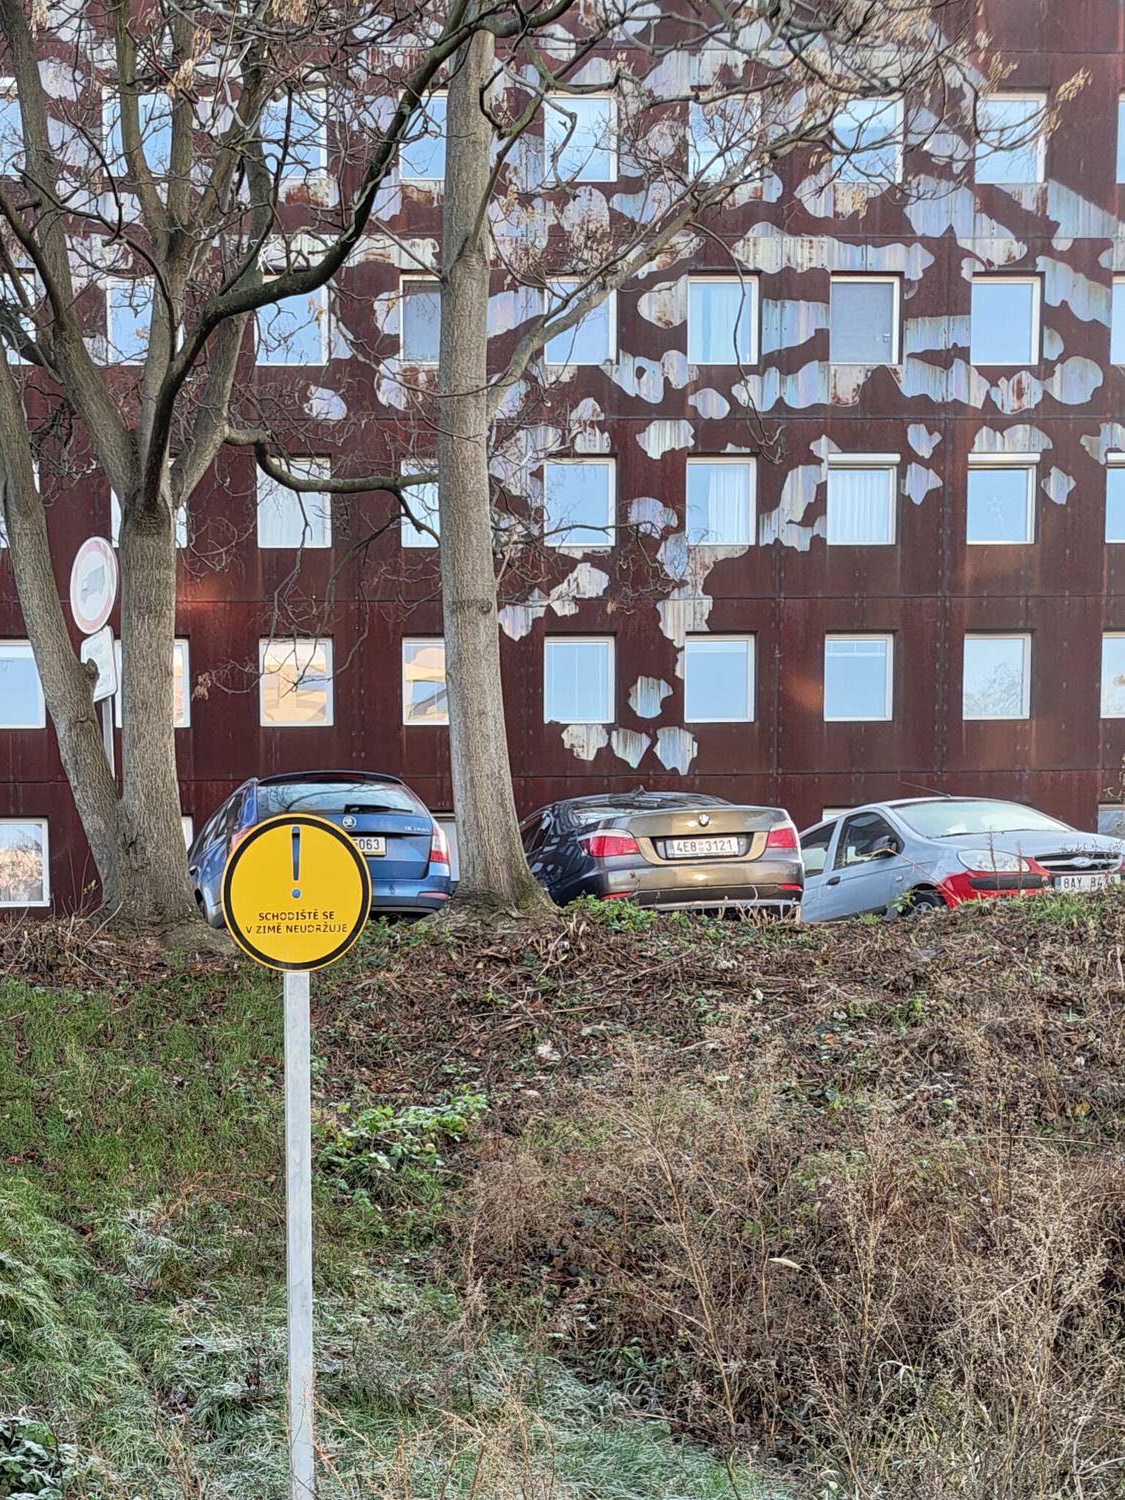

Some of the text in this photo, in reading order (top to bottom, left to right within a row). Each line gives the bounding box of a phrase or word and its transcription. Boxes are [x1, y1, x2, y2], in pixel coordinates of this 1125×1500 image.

[676, 839, 733, 853] 4E8 3121
[258, 909, 335, 921] SCHODIŠTĚ SE
[246, 922, 348, 934] V ZIMĚ NEUDRŽUJE
